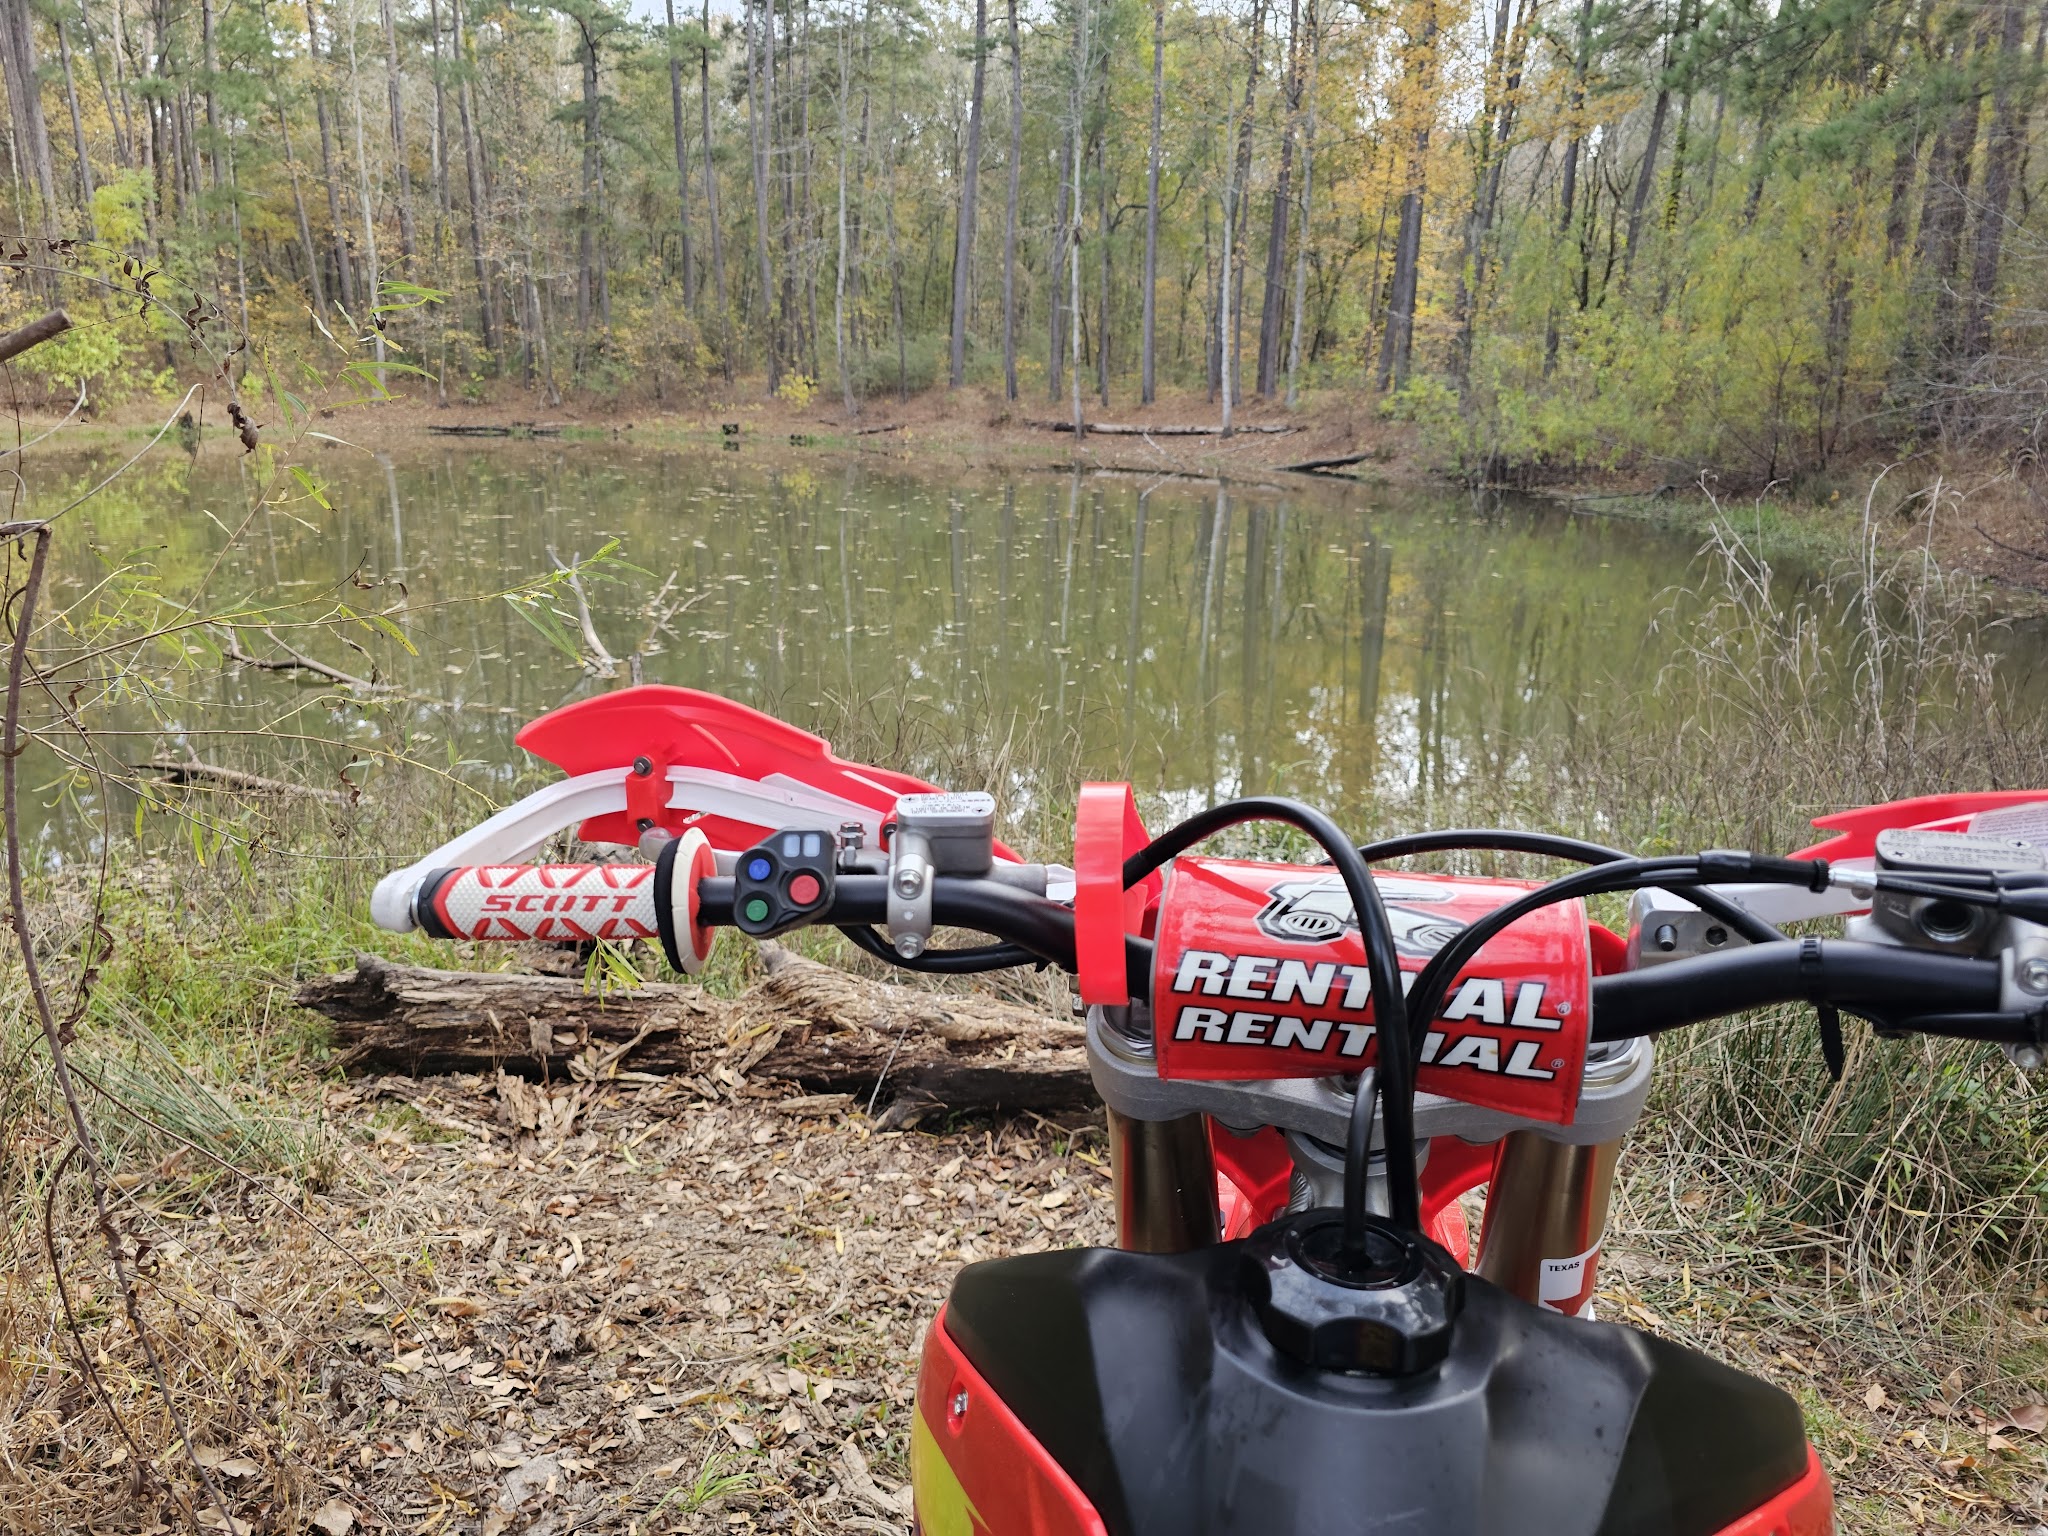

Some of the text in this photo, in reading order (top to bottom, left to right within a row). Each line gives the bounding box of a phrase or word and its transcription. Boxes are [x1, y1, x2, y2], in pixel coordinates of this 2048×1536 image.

[480, 894, 638, 912] SCOTT
[1173, 950, 1562, 1030] RENTAL
[1549, 1261, 1580, 1272] TEXAS
